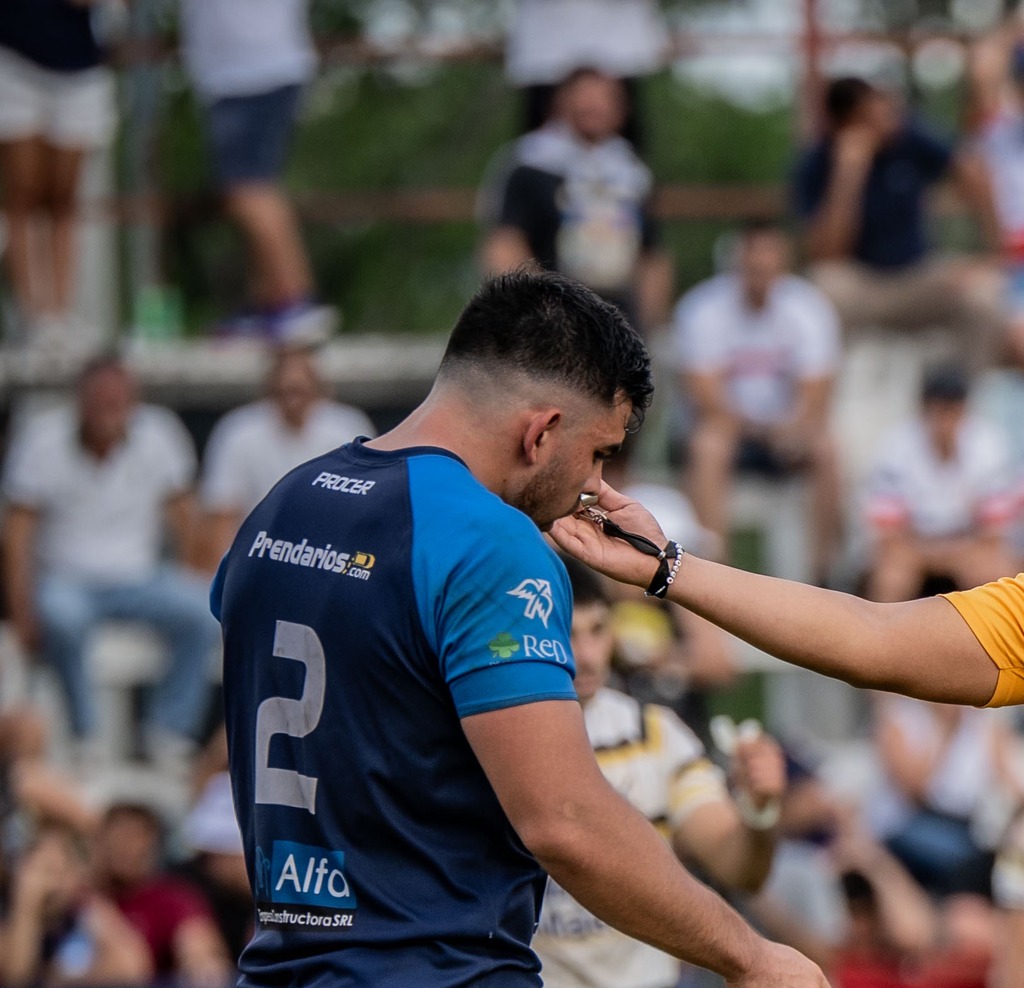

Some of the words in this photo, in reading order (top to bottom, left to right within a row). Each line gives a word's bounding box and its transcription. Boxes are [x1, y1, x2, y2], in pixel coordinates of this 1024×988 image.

[311, 471, 376, 495] PROCER
[254, 619, 327, 815] 2
[274, 853, 350, 898] Alfa
[332, 914, 354, 927] SRL
